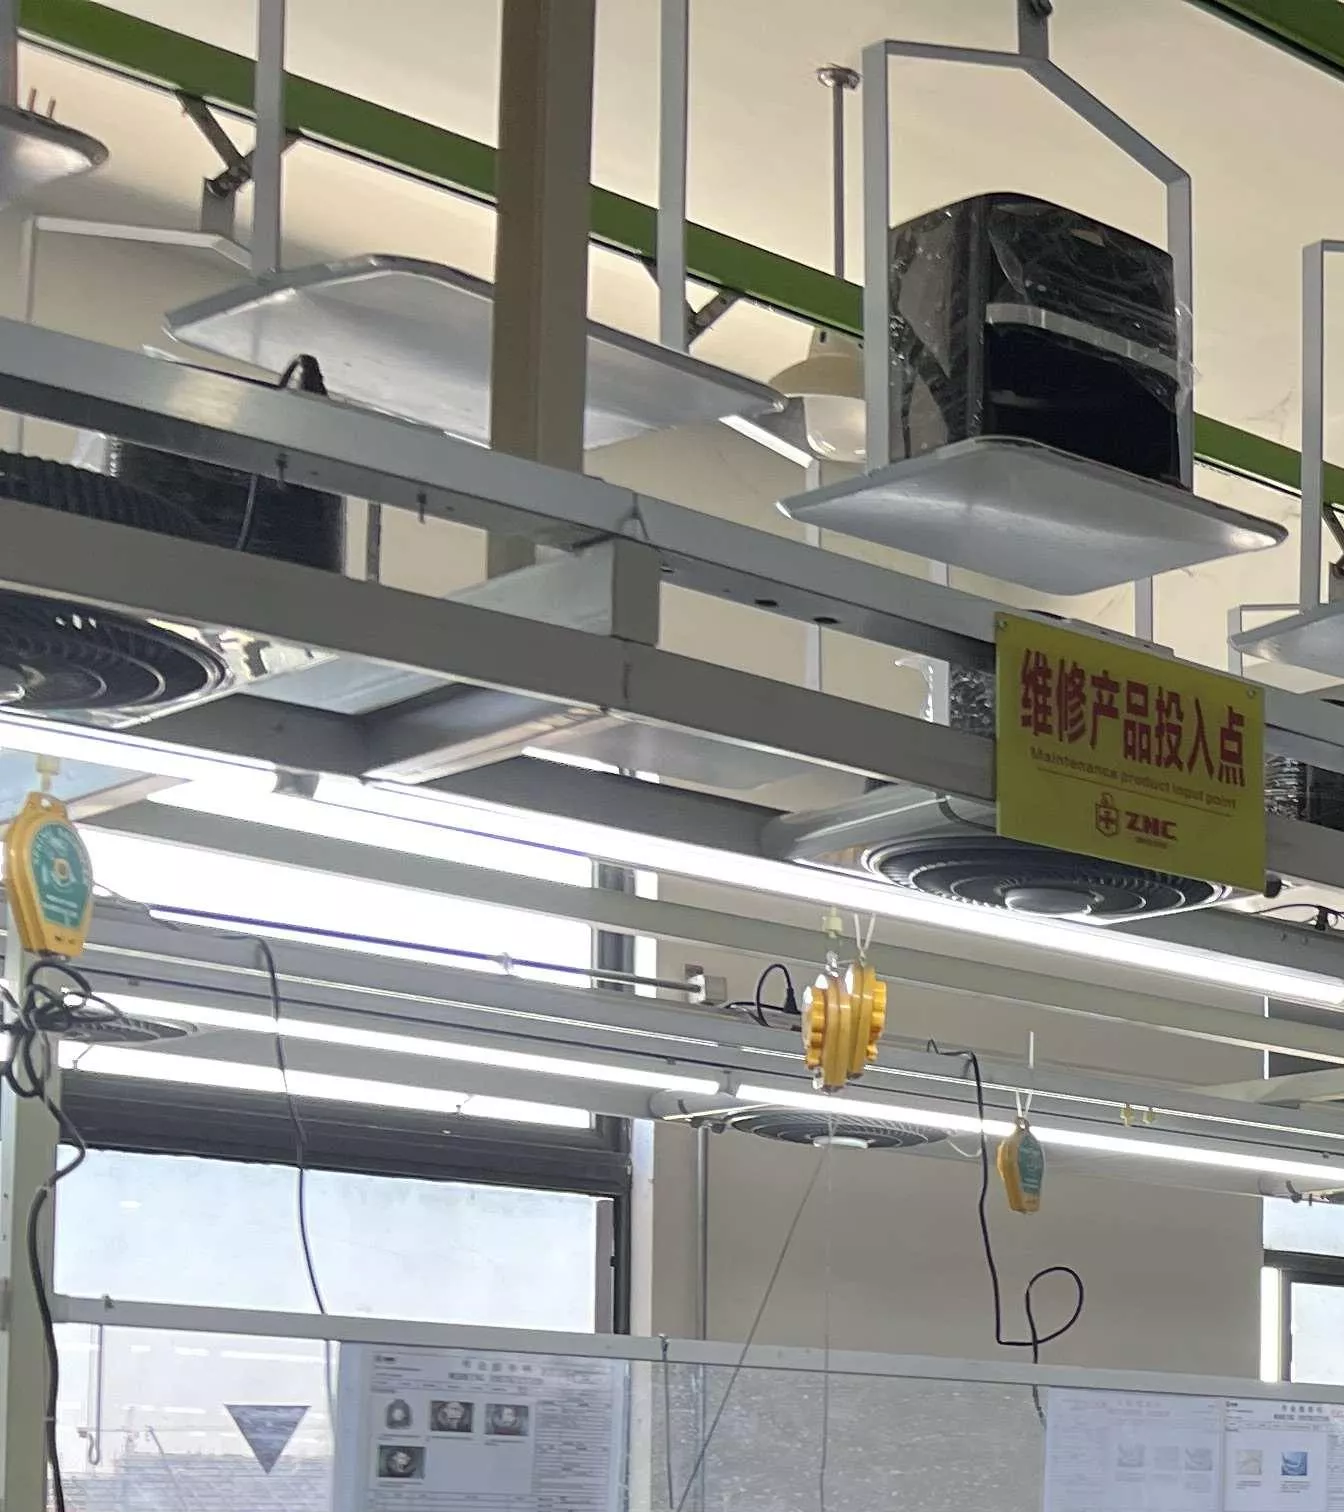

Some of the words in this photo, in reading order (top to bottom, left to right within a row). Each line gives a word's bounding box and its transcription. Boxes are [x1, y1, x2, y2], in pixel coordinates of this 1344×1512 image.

[1020, 648, 1246, 787] 维修产品投入点
